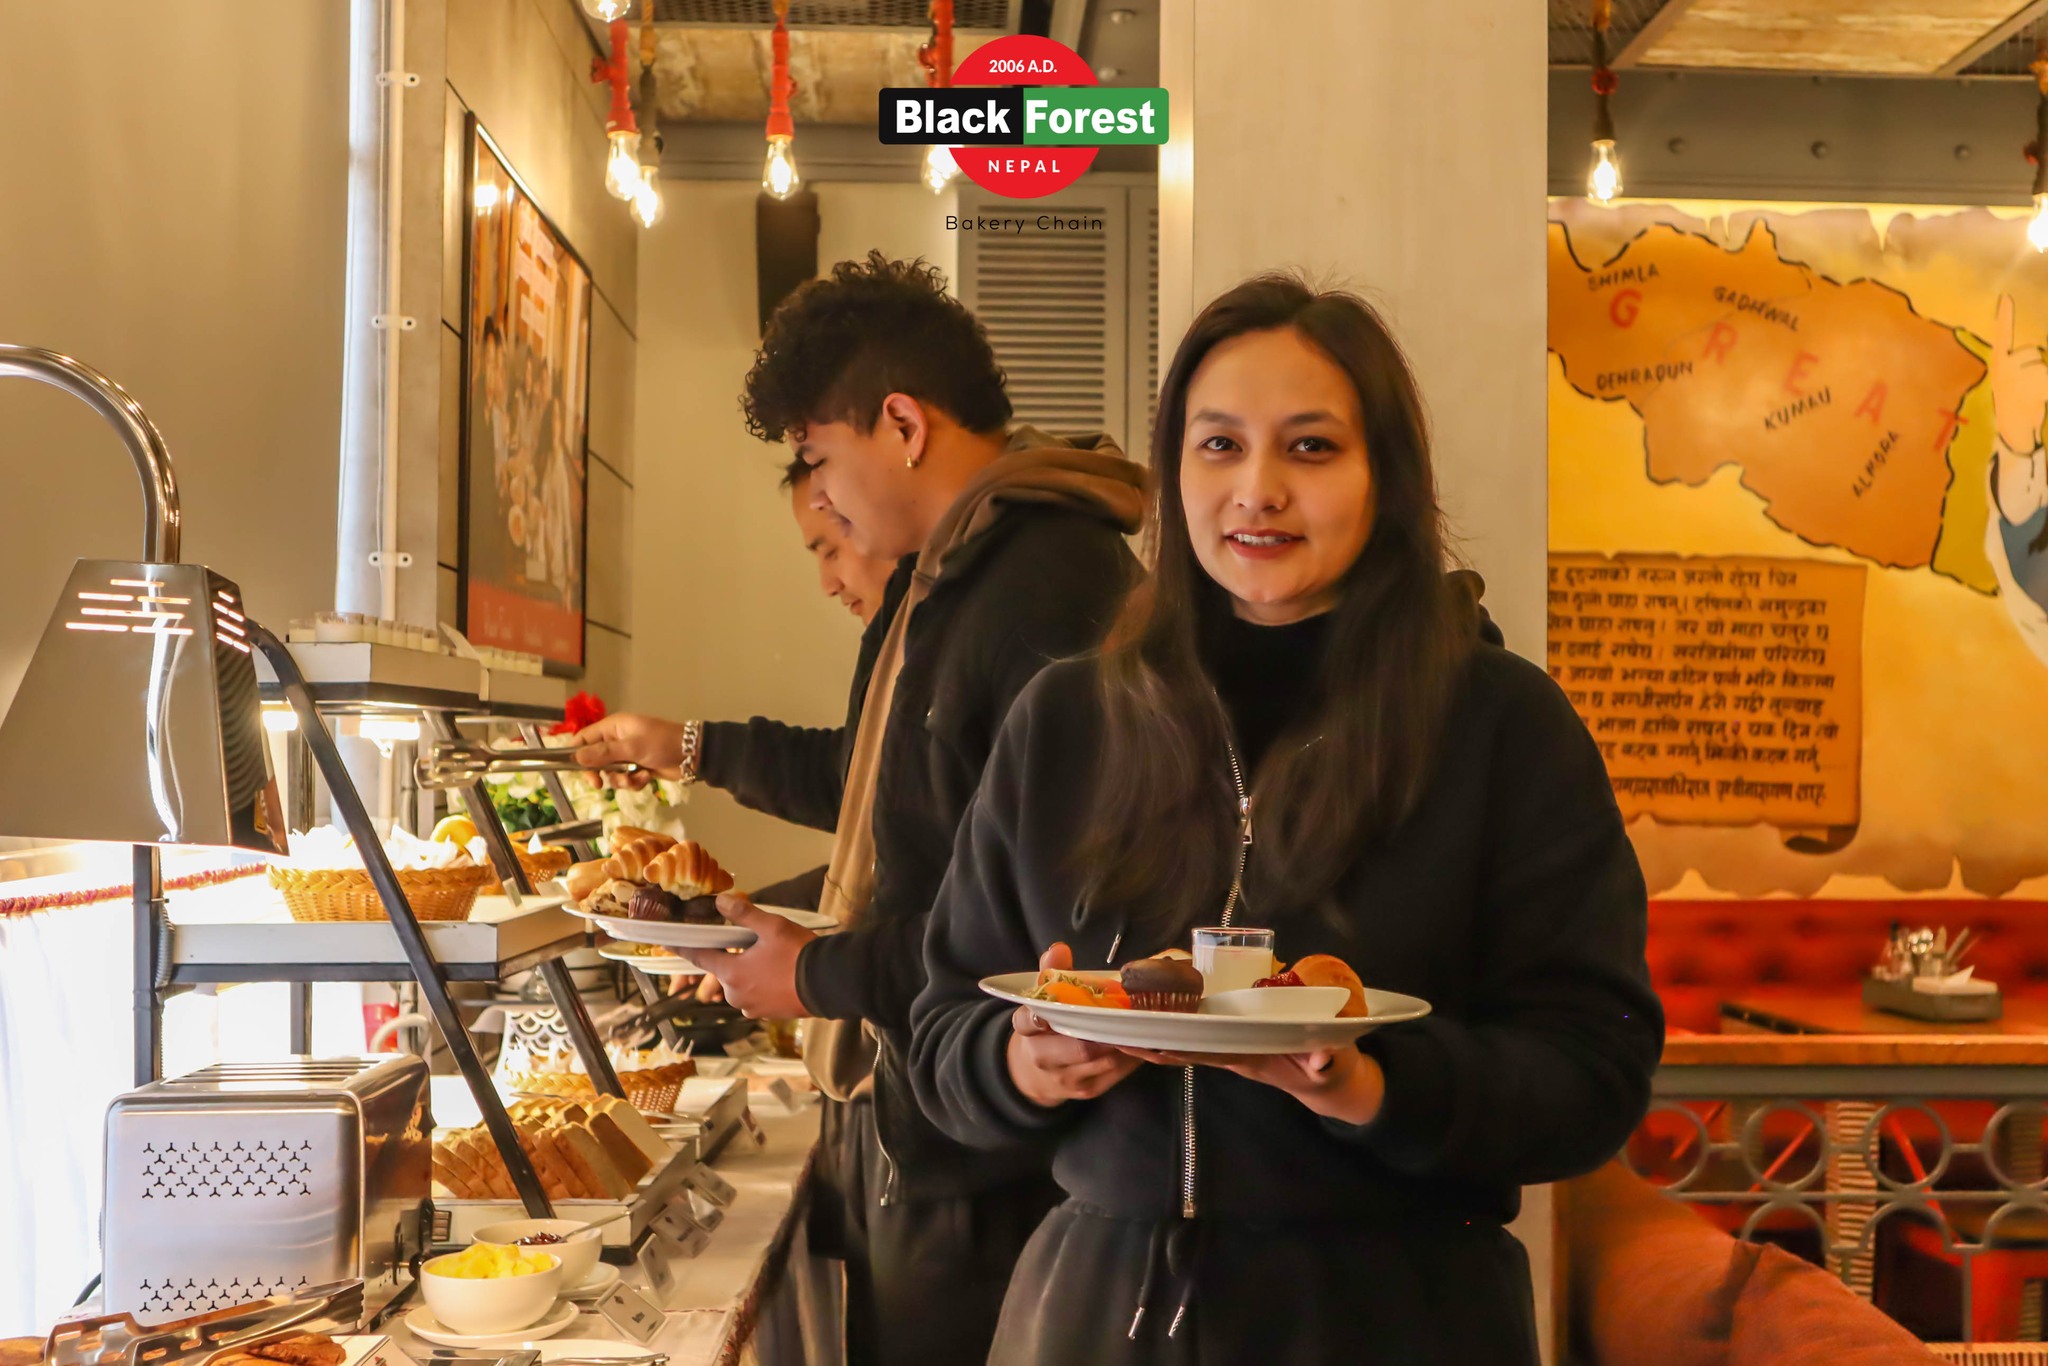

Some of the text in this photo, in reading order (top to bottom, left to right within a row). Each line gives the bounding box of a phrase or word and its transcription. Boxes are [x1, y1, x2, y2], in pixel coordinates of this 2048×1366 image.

[1588, 263, 1660, 292] SHIMLA
[1596, 361, 1694, 391] DEHRADUN
[1852, 430, 1899, 498] ALMORA
